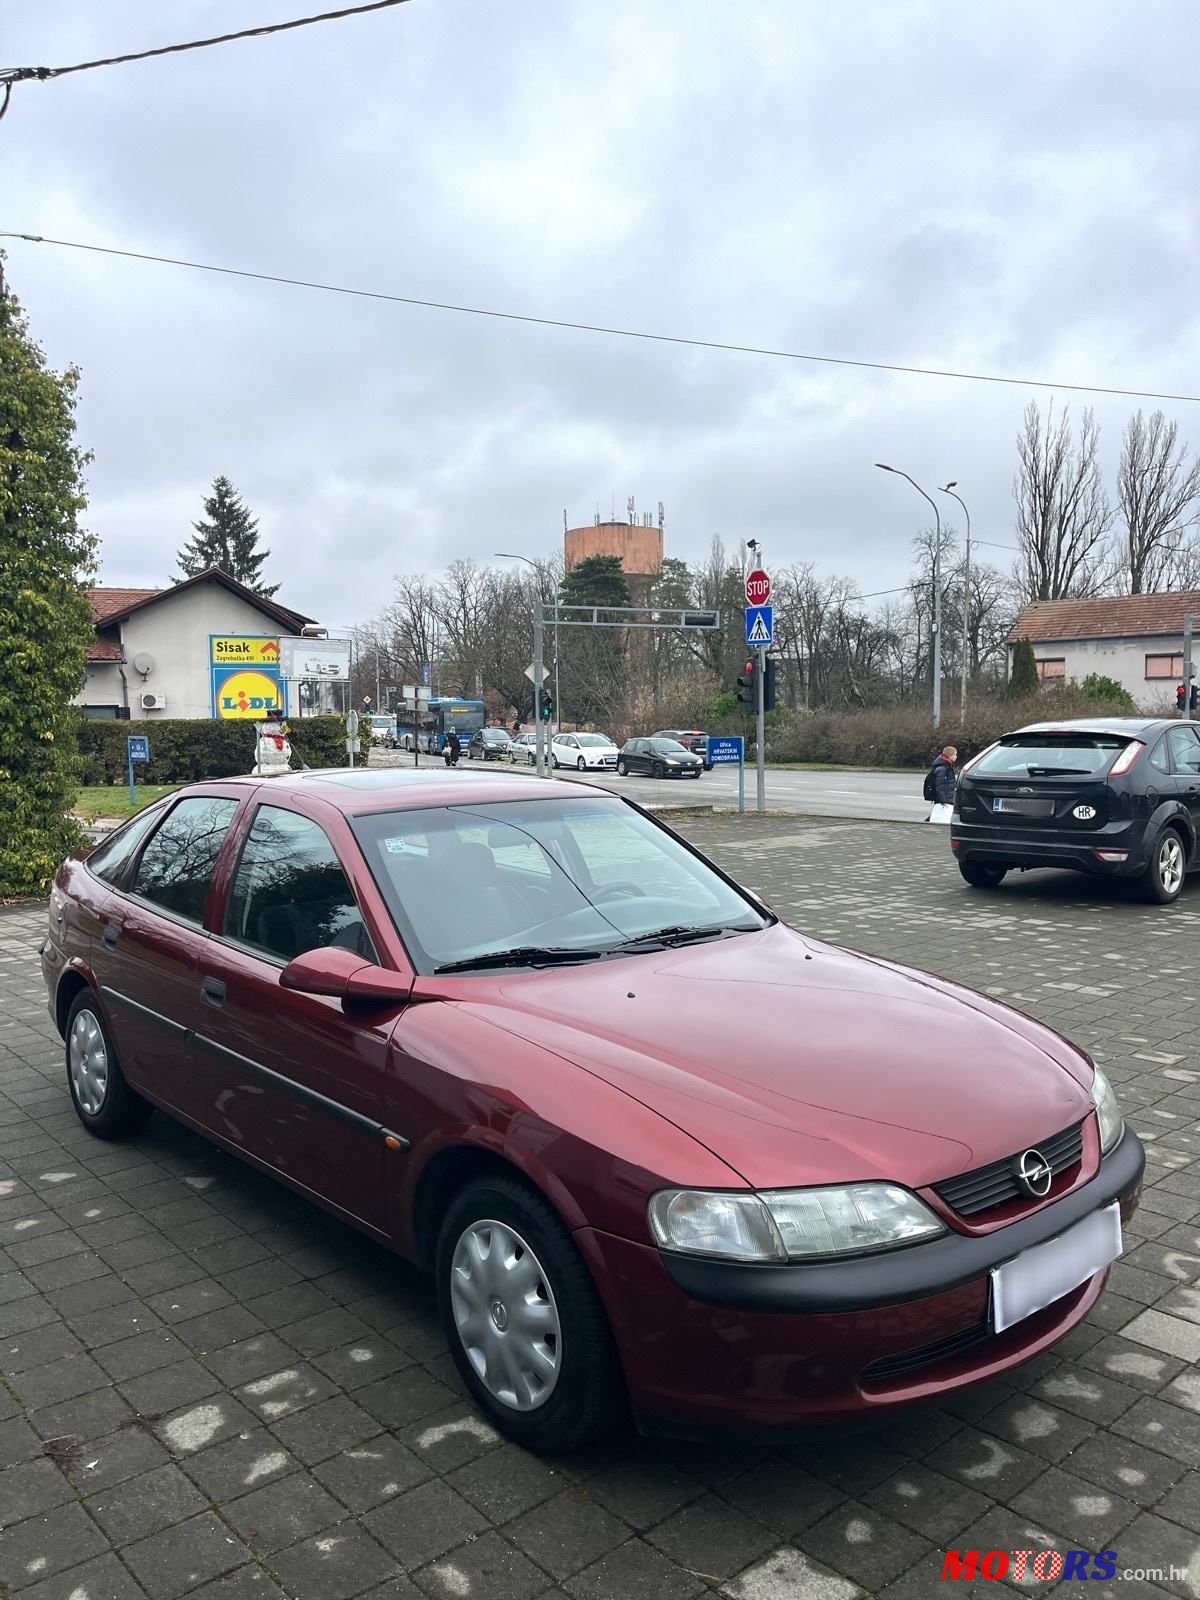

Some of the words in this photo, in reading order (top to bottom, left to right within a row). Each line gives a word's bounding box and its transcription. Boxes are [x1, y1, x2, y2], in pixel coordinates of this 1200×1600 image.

[747, 580, 769, 597] STOP
[216, 641, 250, 653] Sisak
[1078, 807, 1091, 818] HR
